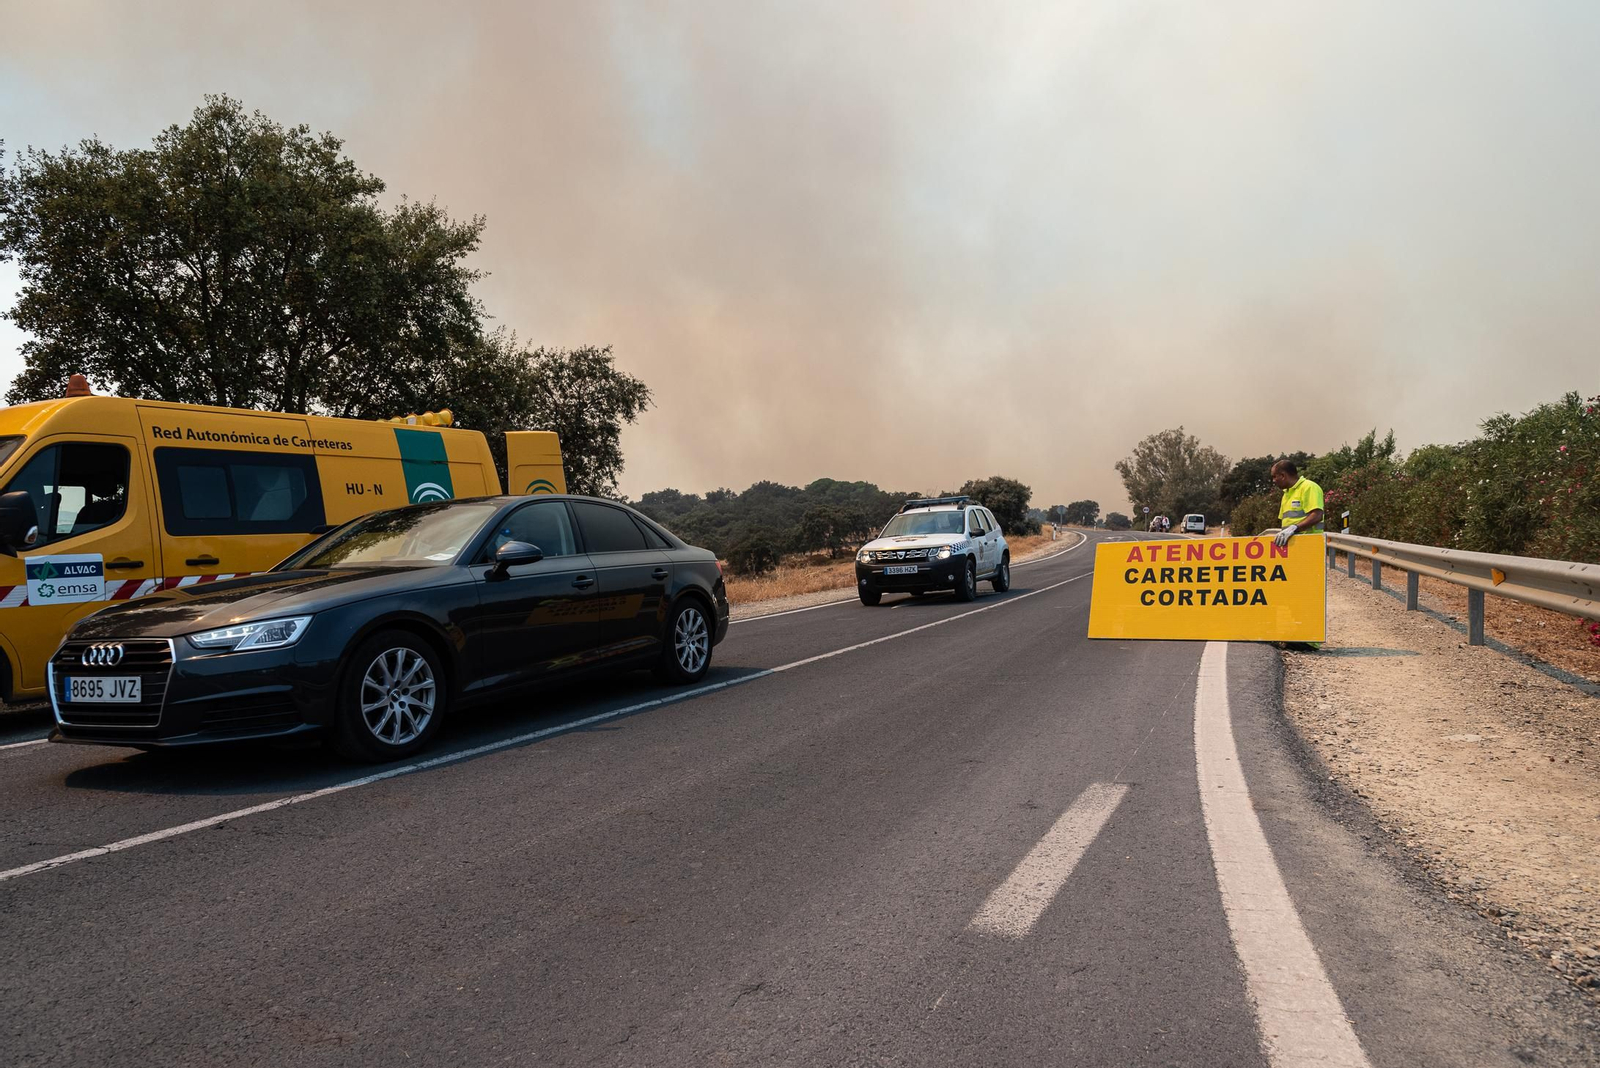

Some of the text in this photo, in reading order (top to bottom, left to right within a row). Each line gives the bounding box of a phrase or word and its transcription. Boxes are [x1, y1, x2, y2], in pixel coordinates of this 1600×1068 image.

[152, 426, 353, 451] Red Autonómica de Carreteras
[346, 483, 364, 495] HU
[374, 484, 383, 495] N
[1126, 537, 1289, 563] ATENCIÓN
[64, 565, 97, 575] ALVAC
[1124, 565, 1288, 584] CARRETERA
[58, 583, 97, 594] emsa
[1140, 589, 1268, 606] CORTADA
[72, 680, 137, 698] 8695 JVZ
